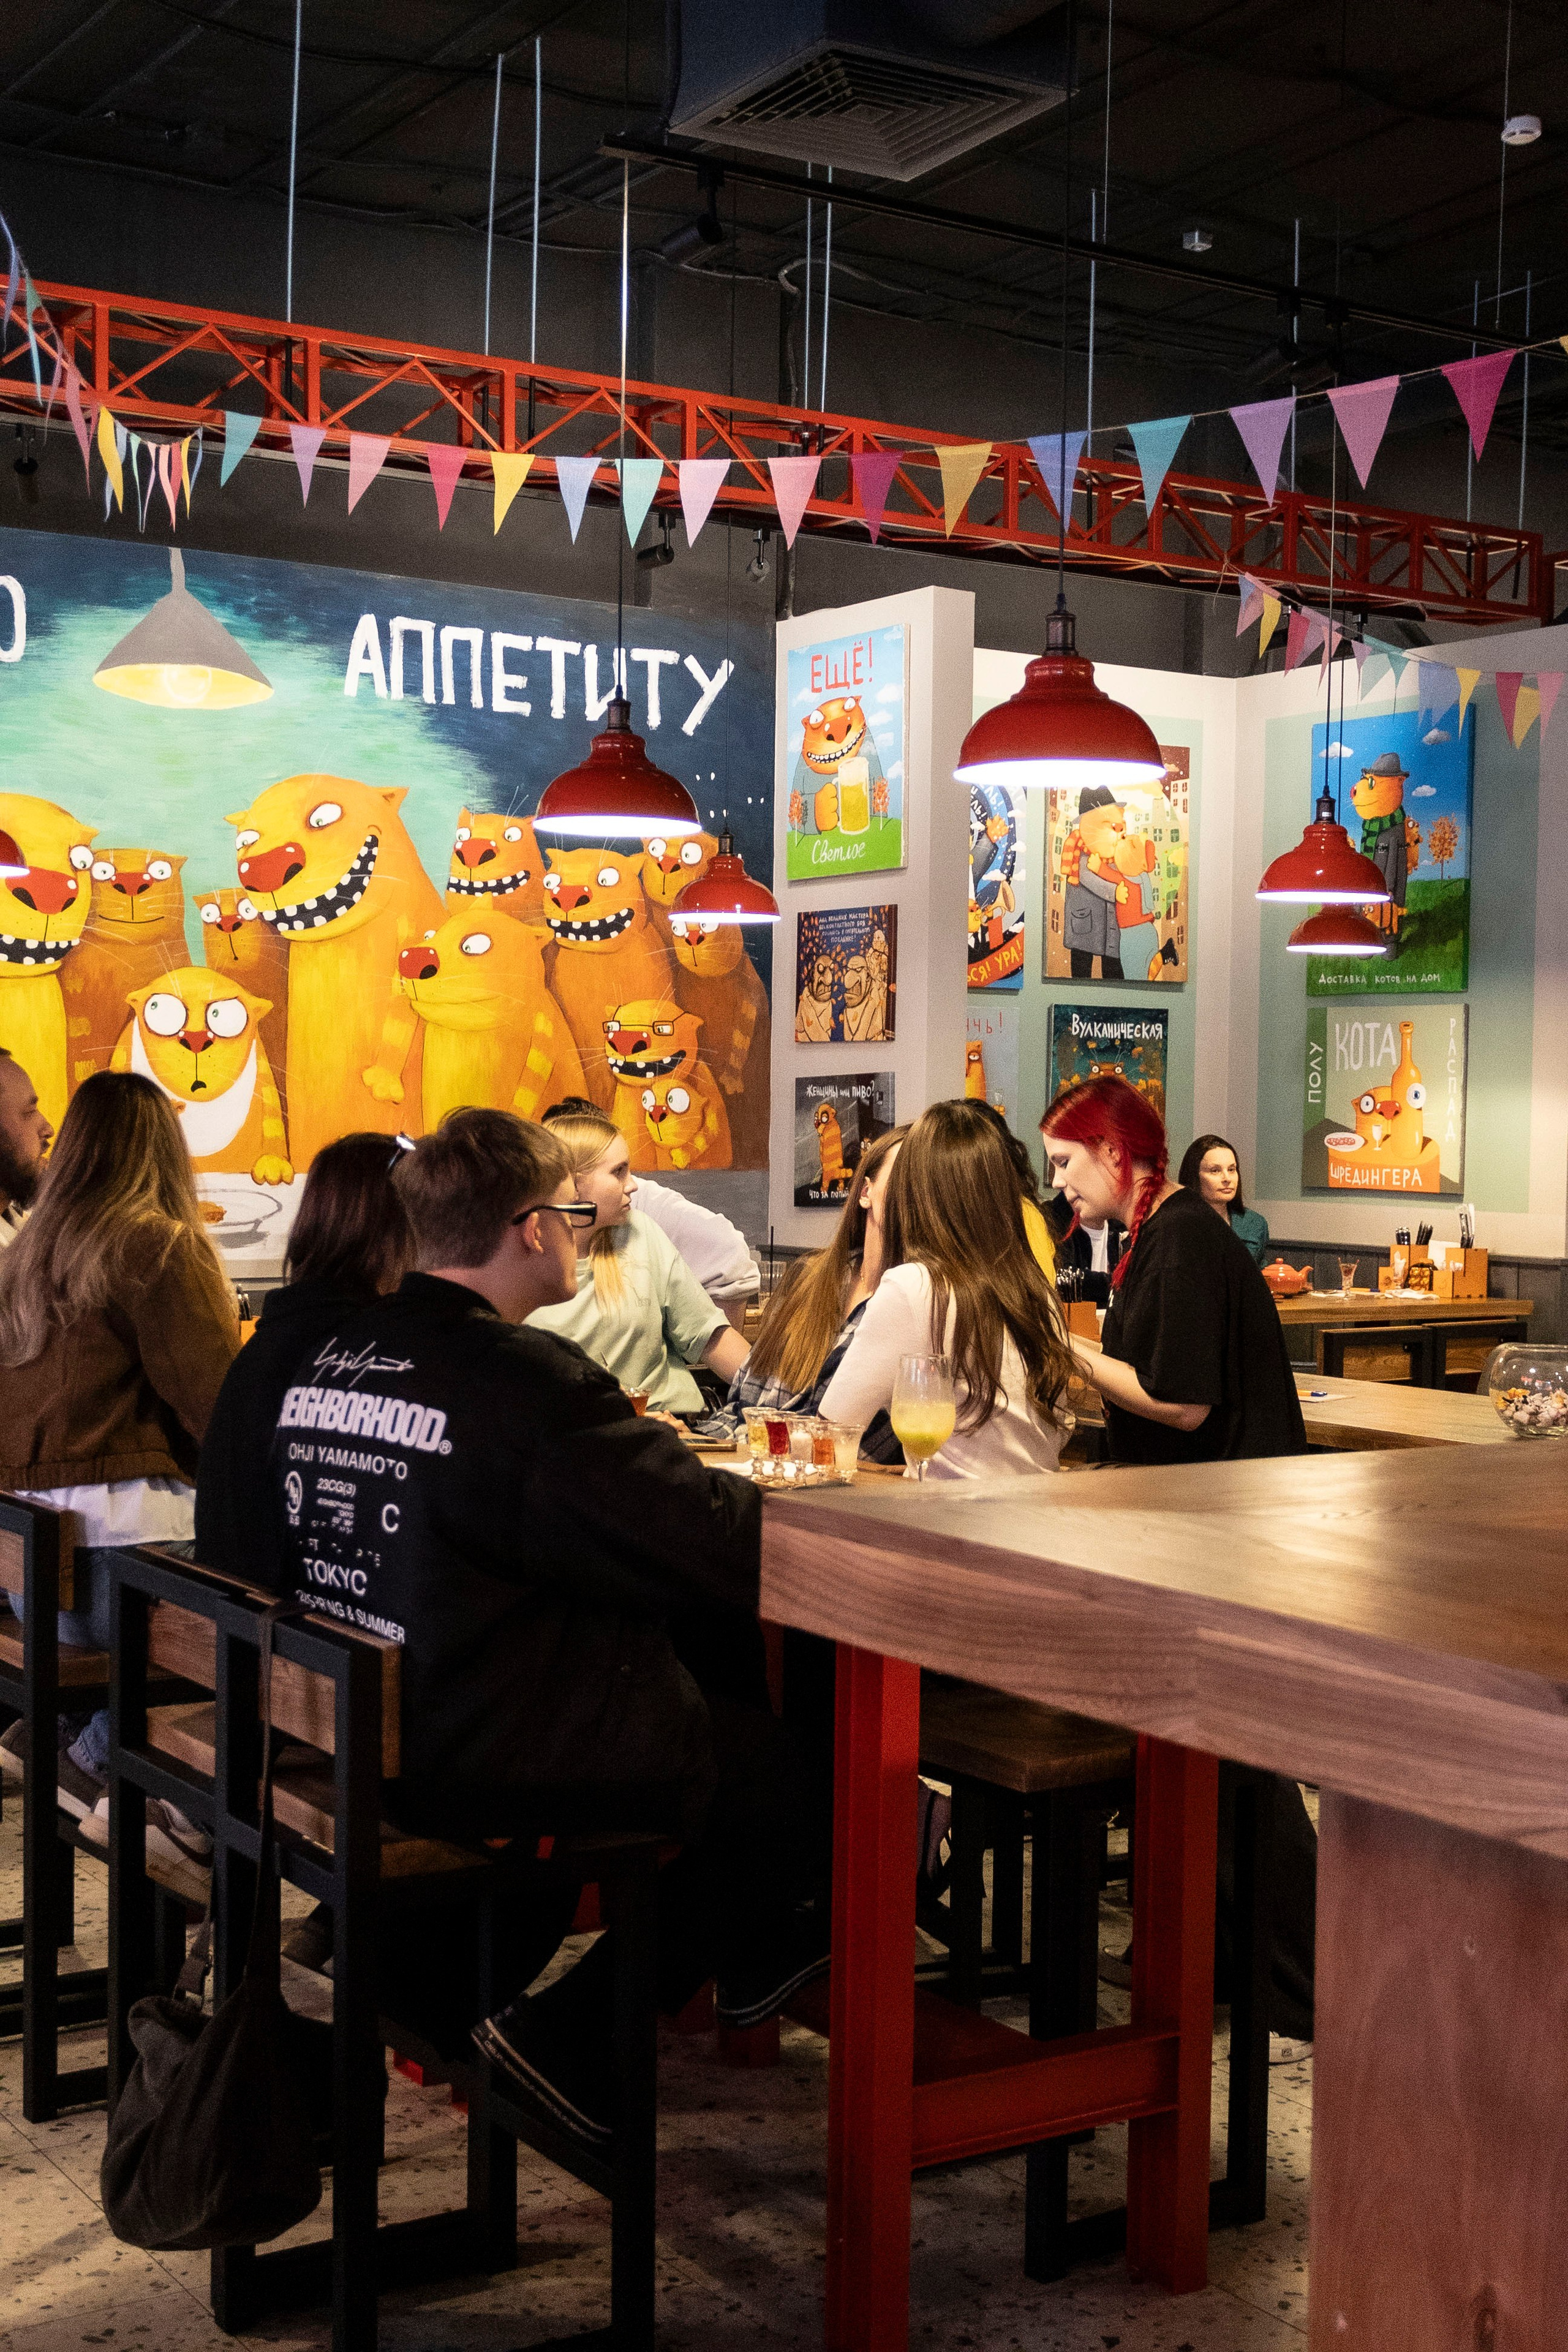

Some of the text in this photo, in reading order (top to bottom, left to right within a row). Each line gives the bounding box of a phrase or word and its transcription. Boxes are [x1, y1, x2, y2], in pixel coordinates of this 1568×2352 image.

[344, 613, 736, 736] АППЕТИТУ
[811, 637, 873, 693] ЕЩЁ!
[812, 839, 865, 864] Светлое
[994, 939, 1022, 971] УРА!
[1319, 973, 1367, 984] ДОСТАВКА
[1375, 975, 1400, 984] КОТОВ
[1421, 973, 1440, 982] ДОМ
[1072, 1013, 1163, 1040] ВУЛКАНИЧЕСКАЯ
[1335, 1022, 1397, 1071] КОТА
[1308, 1041, 1324, 1103] ПОЛУ
[1446, 1018, 1457, 1142] РАСПАД
[806, 1084, 838, 1098] ЖЕНЩИНЫ
[852, 1080, 875, 1099] ПИВО?
[1330, 1163, 1422, 1188] ШРЁДИНГЕРА
[809, 1189, 820, 1199] ЧТО
[821, 1190, 828, 1199] ЗА
[317, 1446, 407, 1480] YAMAMOTO
[355, 1608, 405, 1645] SUMMER
